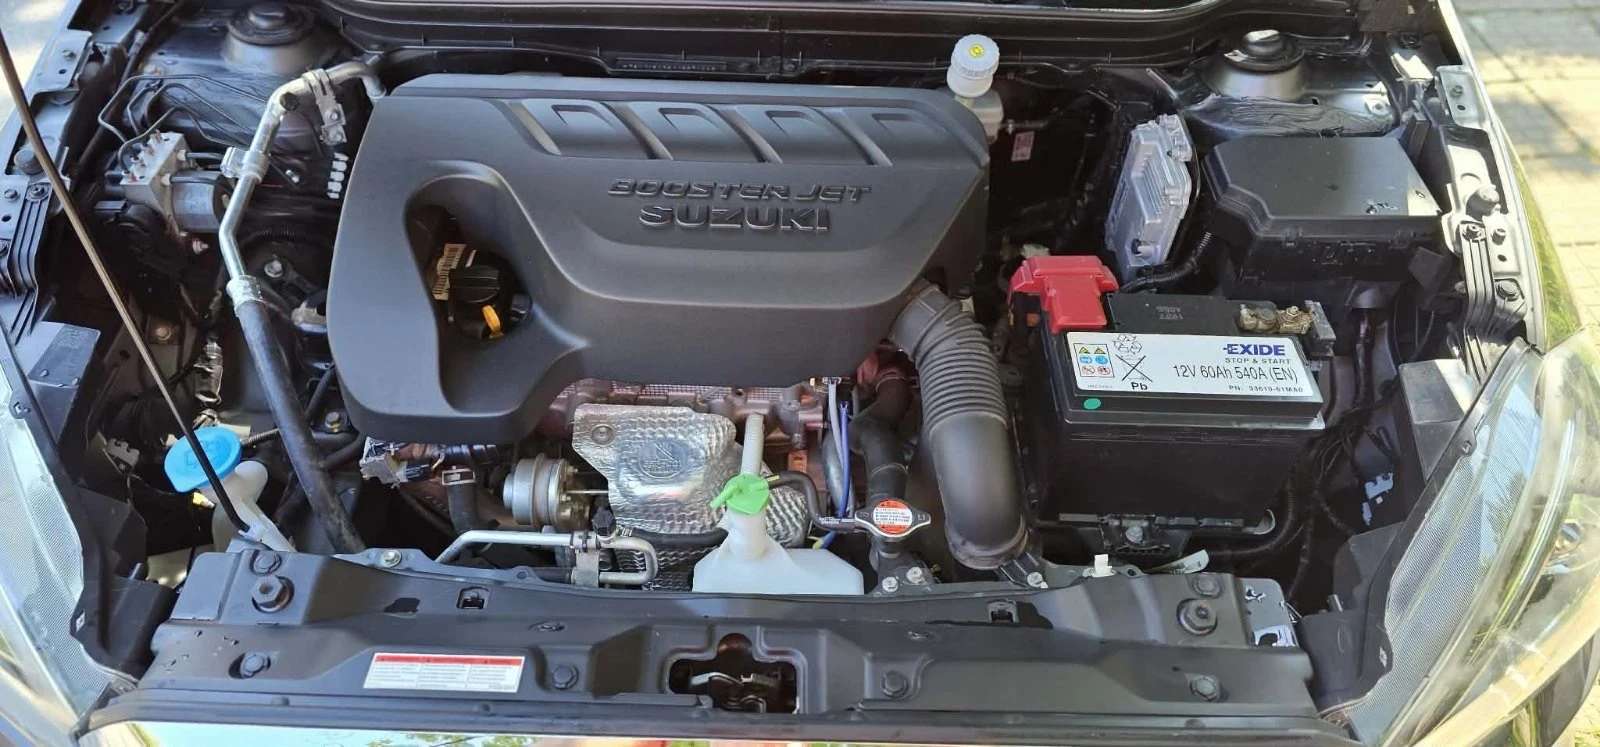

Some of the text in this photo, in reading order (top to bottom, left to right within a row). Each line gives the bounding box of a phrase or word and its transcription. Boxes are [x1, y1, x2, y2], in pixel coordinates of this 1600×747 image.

[639, 204, 831, 231] SUZUKI
[1223, 343, 1286, 356] EXIDE
[1173, 364, 1298, 384] 12V 60Ah 540A (EN)
[1131, 381, 1148, 391] Pb
